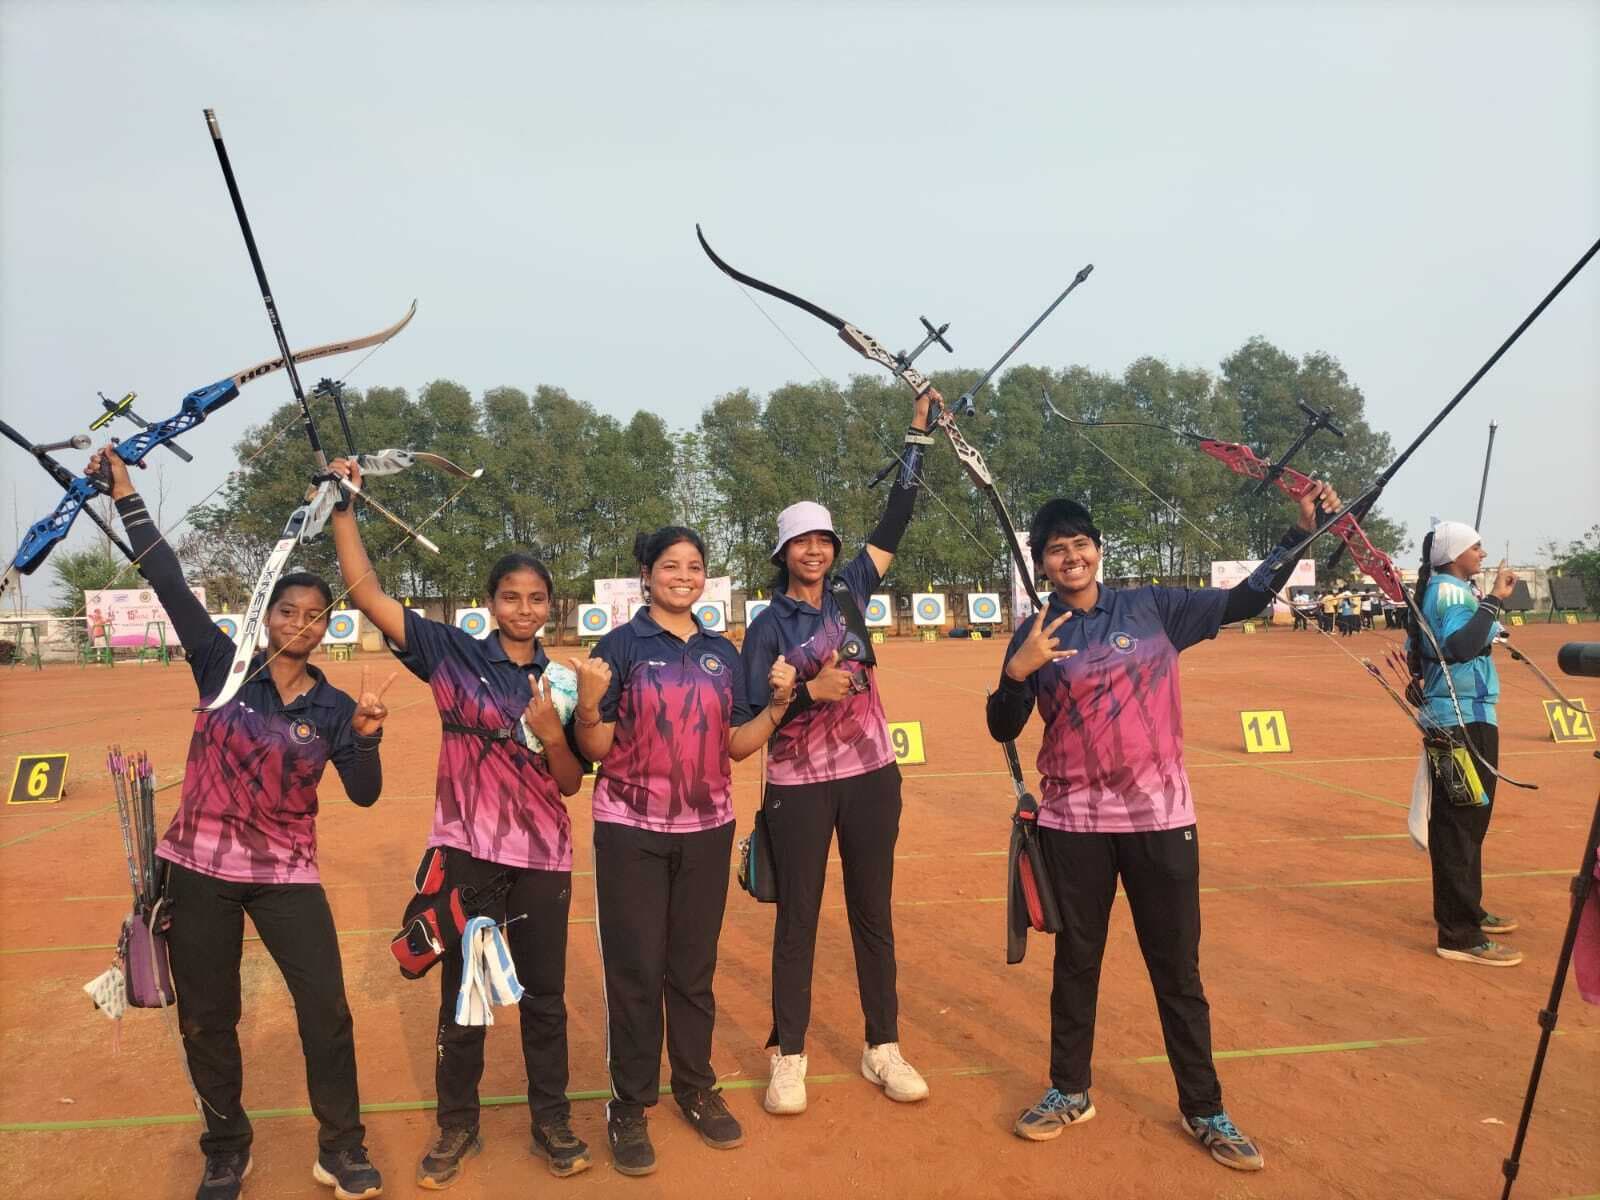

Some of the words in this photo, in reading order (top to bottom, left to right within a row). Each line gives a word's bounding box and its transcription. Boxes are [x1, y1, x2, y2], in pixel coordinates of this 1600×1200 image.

[1248, 716, 1281, 746] 11
[1553, 705, 1588, 737] 12
[892, 728, 909, 759] 9
[28, 762, 50, 797] 6
